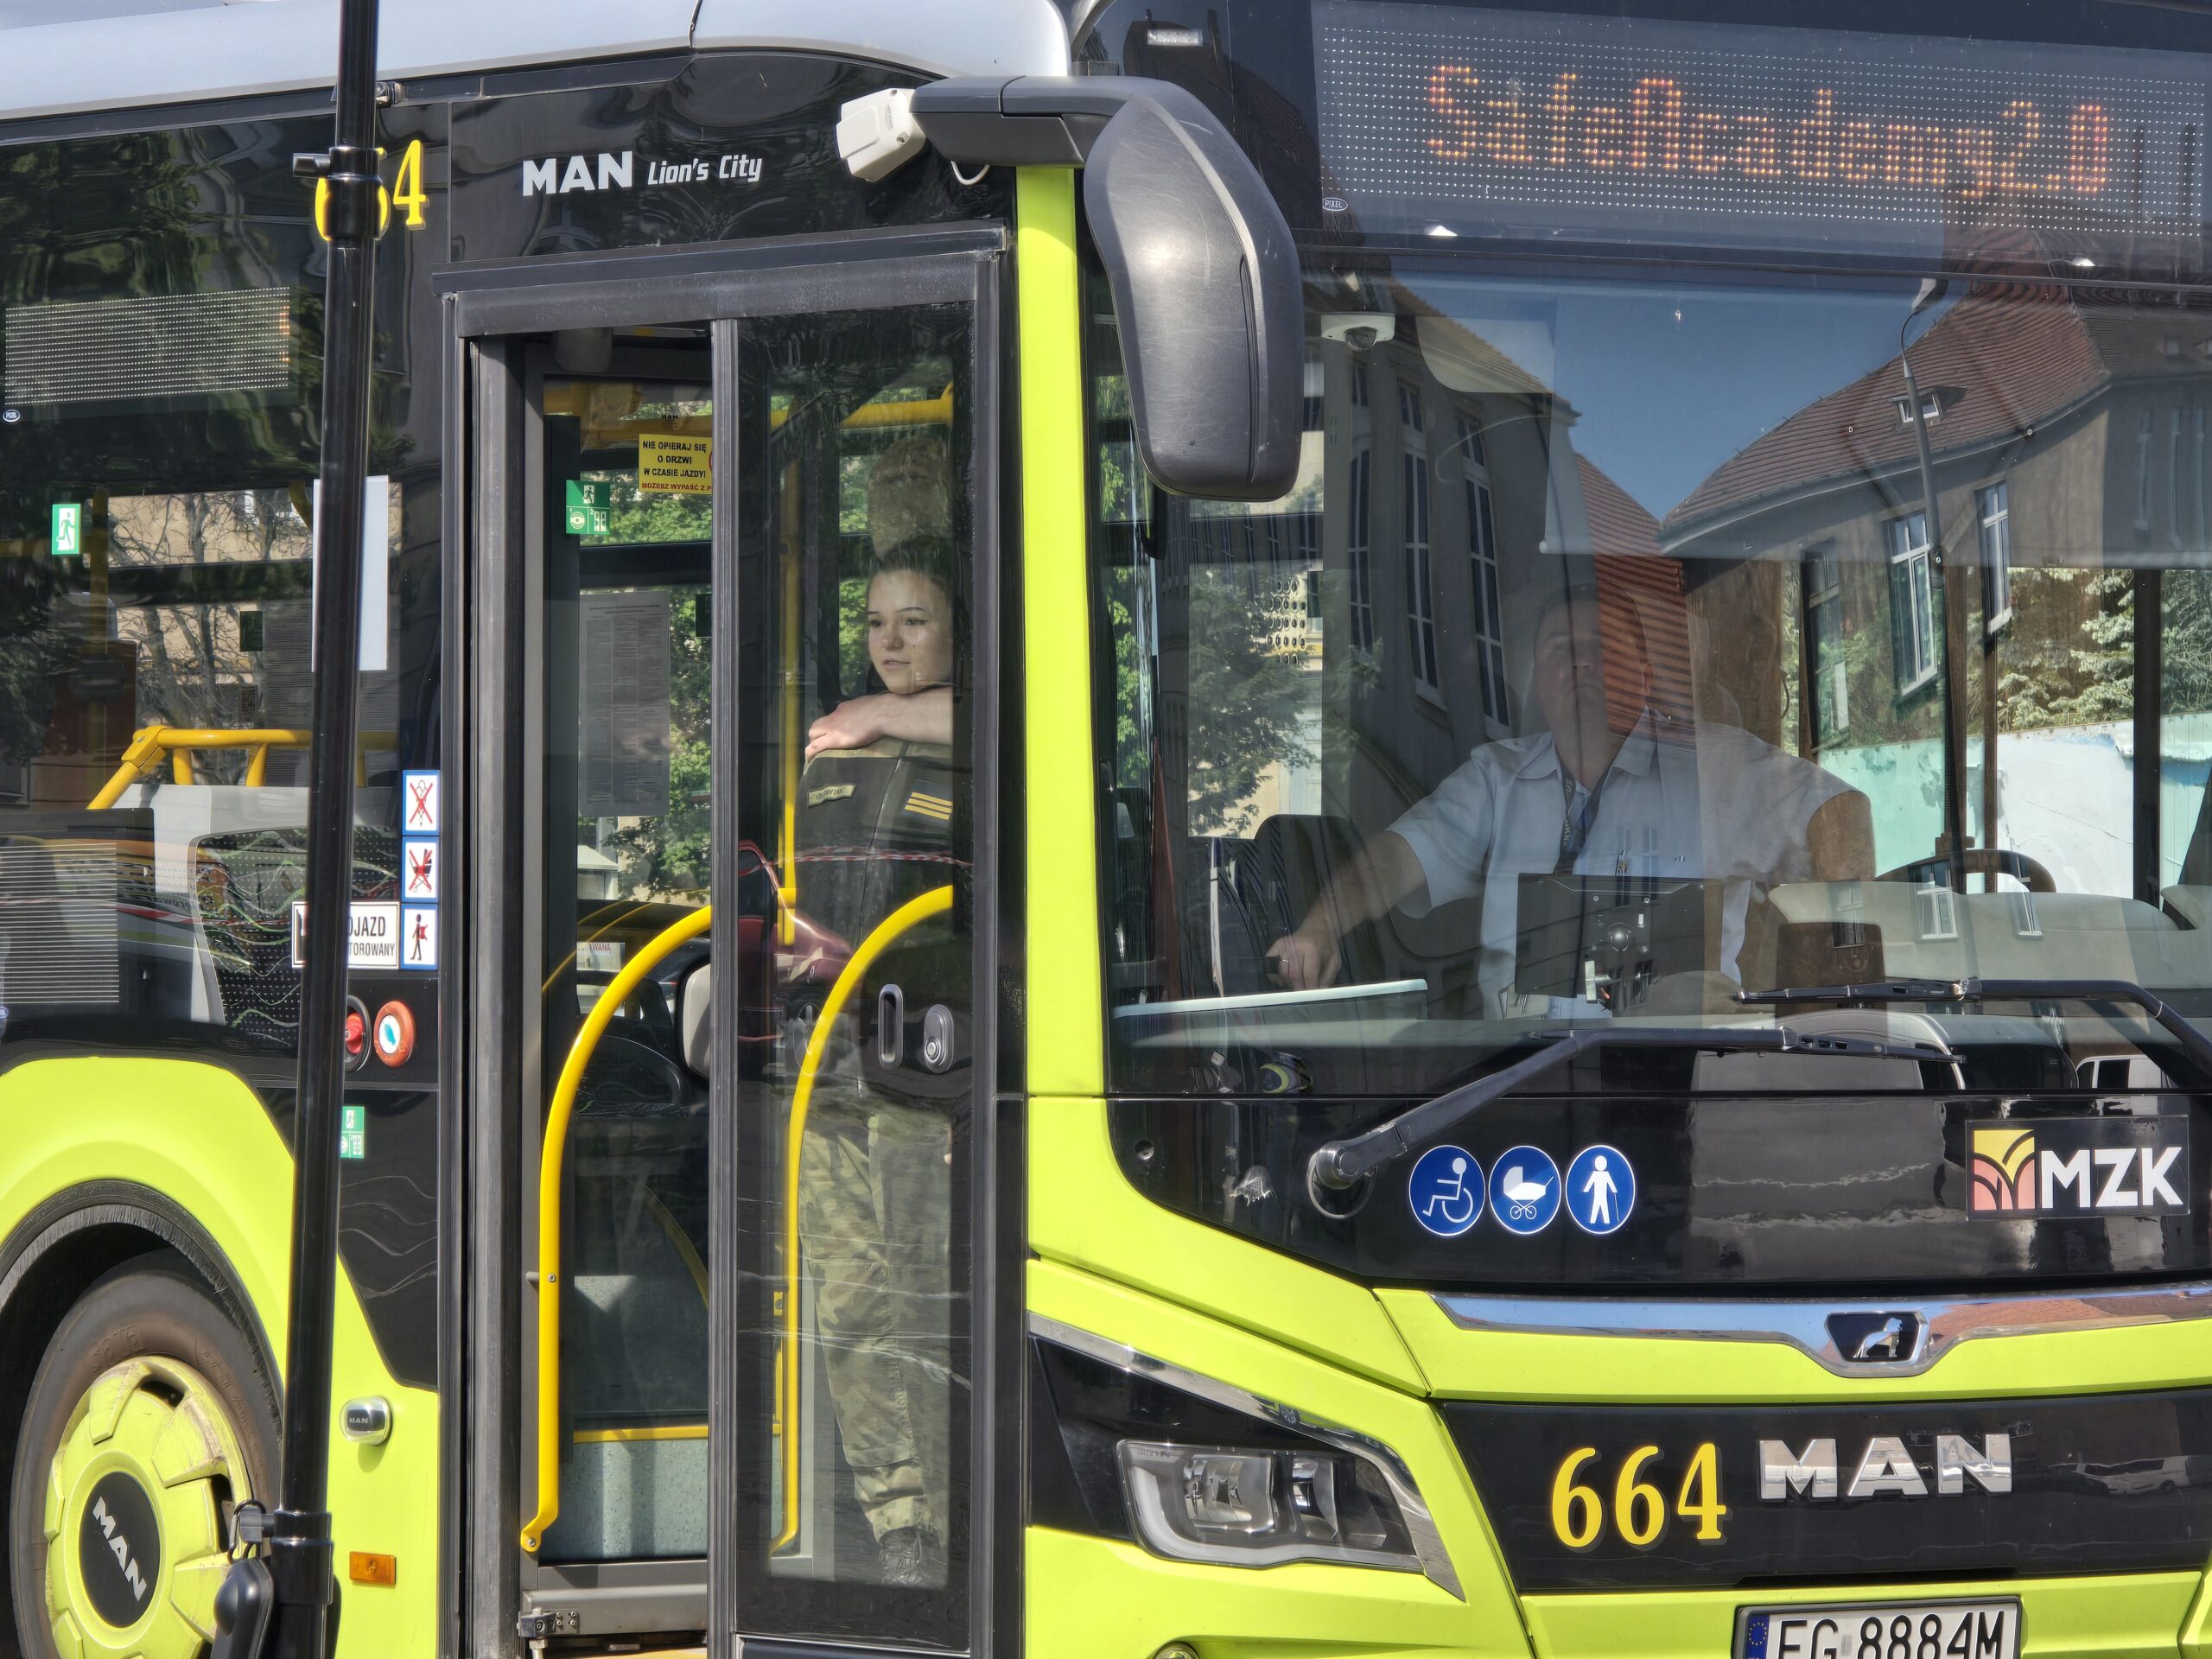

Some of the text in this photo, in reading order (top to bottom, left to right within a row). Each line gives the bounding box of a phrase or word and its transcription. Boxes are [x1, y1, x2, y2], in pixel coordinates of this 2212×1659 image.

[1429, 66, 2107, 195] SafeAcademy2.0
[523, 150, 762, 196] MAN Lion's City
[1325, 200, 1343, 208] PIXEL
[643, 441, 707, 454] NIE OPIERAJ SIĘ
[652, 468, 678, 477] CZASIE
[349, 916, 385, 937] JAZD
[349, 942, 395, 957] TOROWANY
[2041, 1147, 2183, 1209] MZK
[1552, 1433, 2012, 1548] 664 MAN
[92, 1496, 147, 1602] MAN
[1858, 1611, 2005, 1659] 8884M
